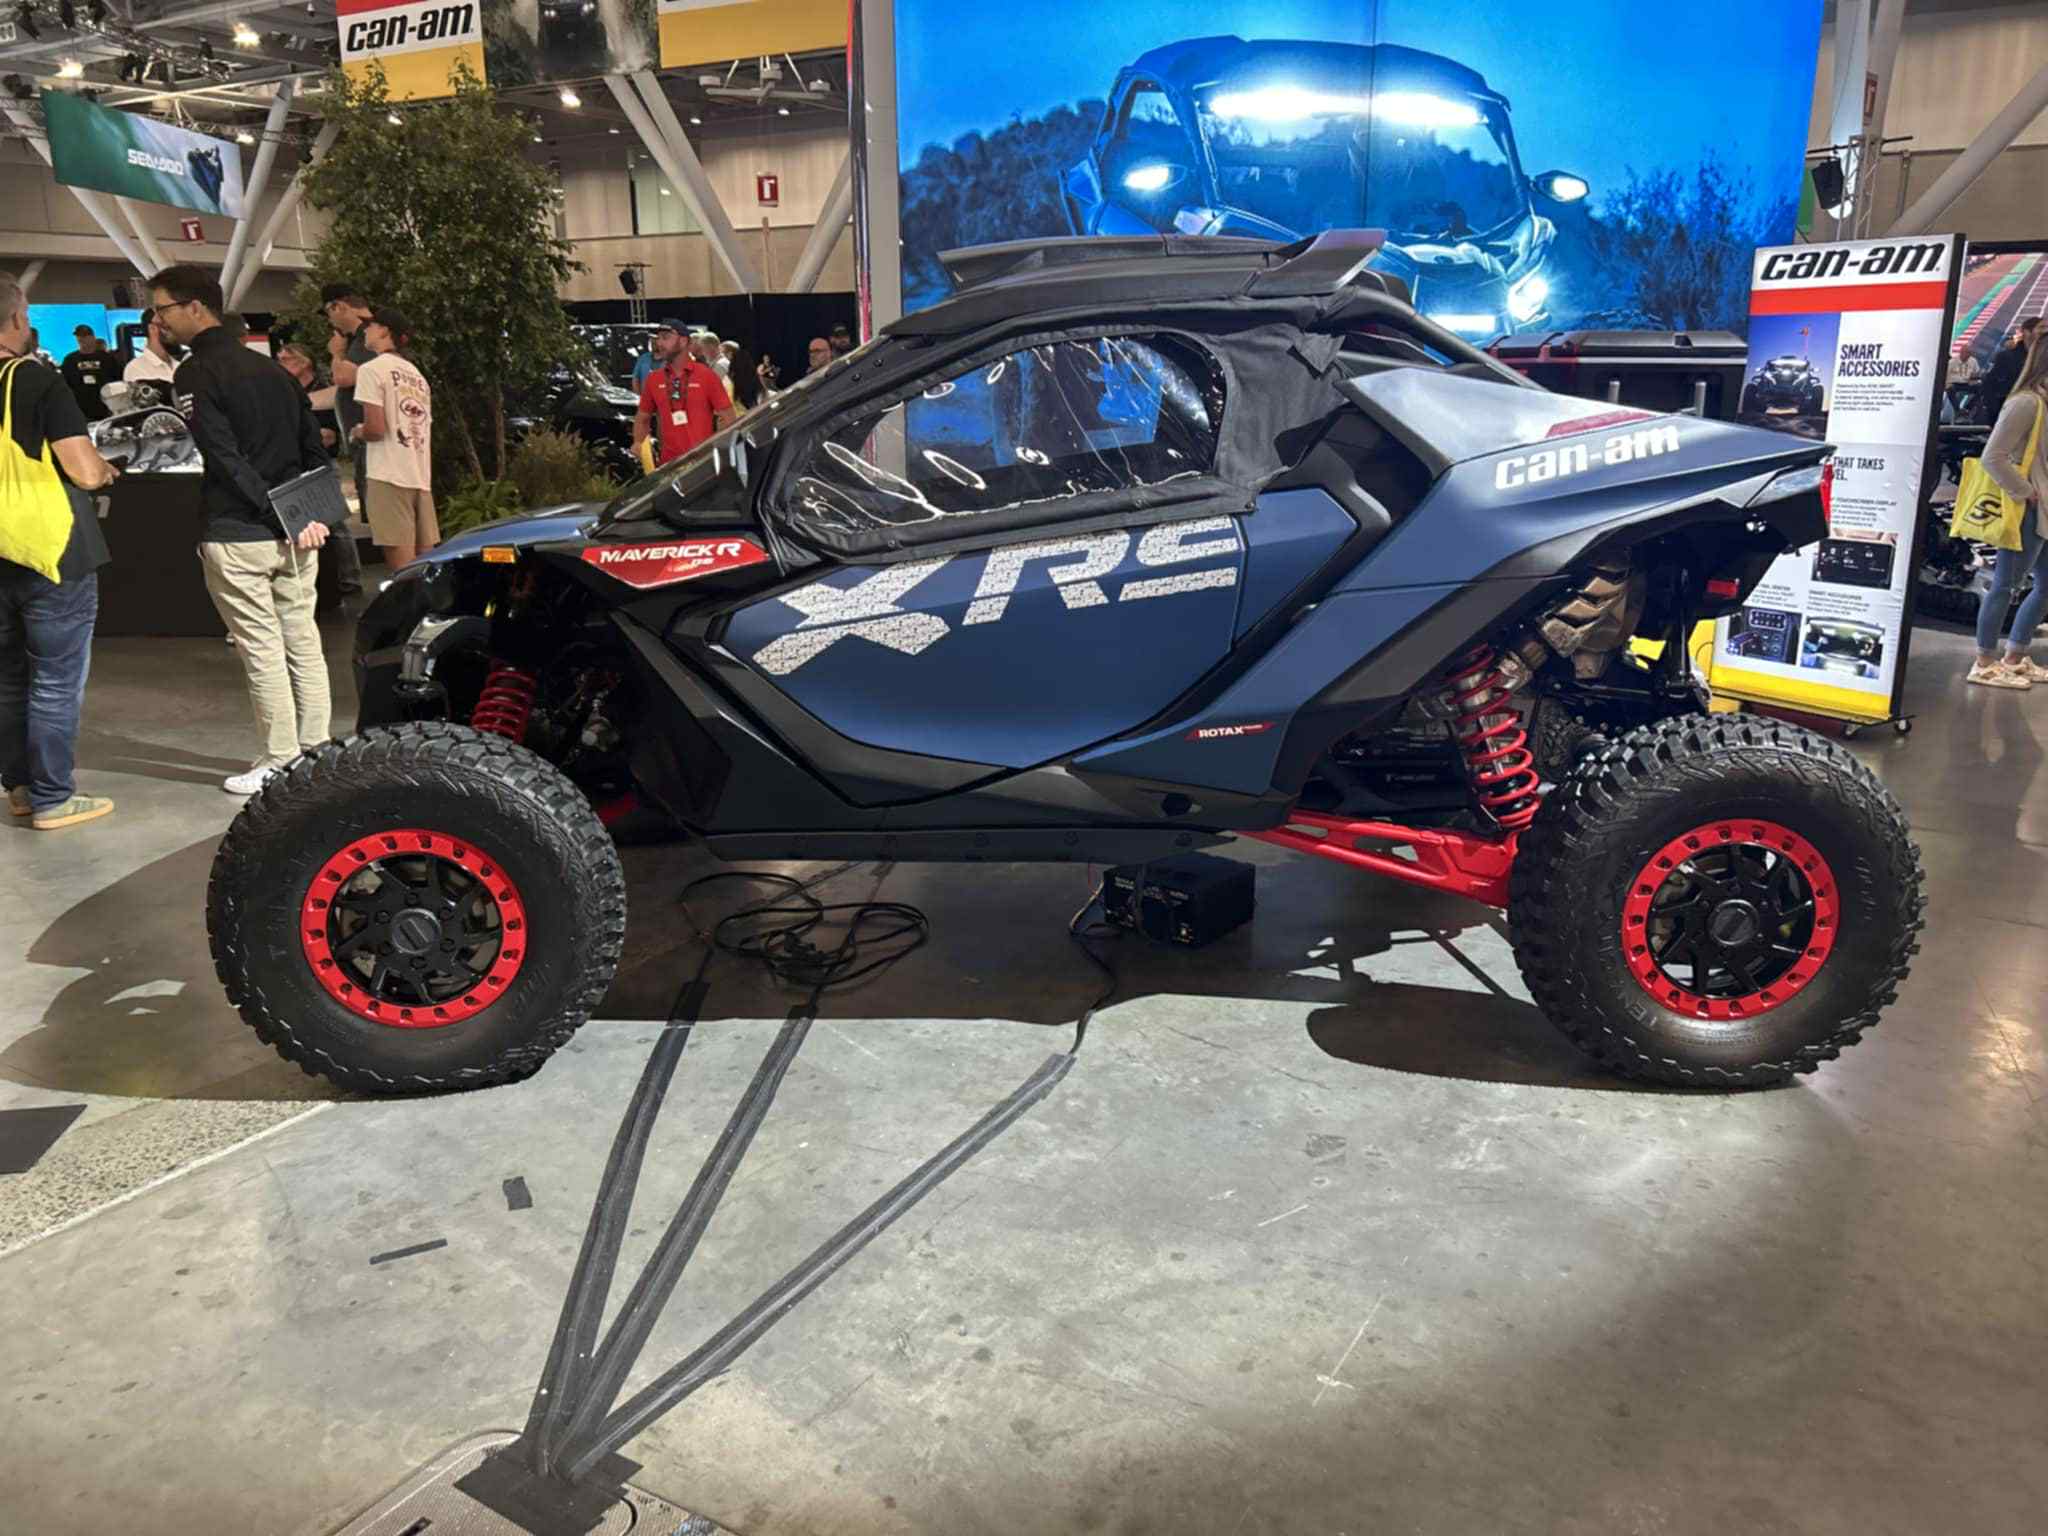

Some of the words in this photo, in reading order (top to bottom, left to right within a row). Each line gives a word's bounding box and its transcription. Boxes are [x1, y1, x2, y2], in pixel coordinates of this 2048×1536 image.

[347, 4, 473, 51] can-am
[1761, 243, 1945, 280] can-am
[1840, 344, 1883, 360] SMART
[1838, 360, 1920, 377] ACCESSORIES
[1495, 425, 1680, 490] can-am
[1833, 456, 1855, 469] THAT
[1857, 457, 1885, 471] TAKES
[600, 543, 715, 563] MAVERICK
[717, 542, 741, 557] R
[1199, 726, 1245, 738] ROTAX
